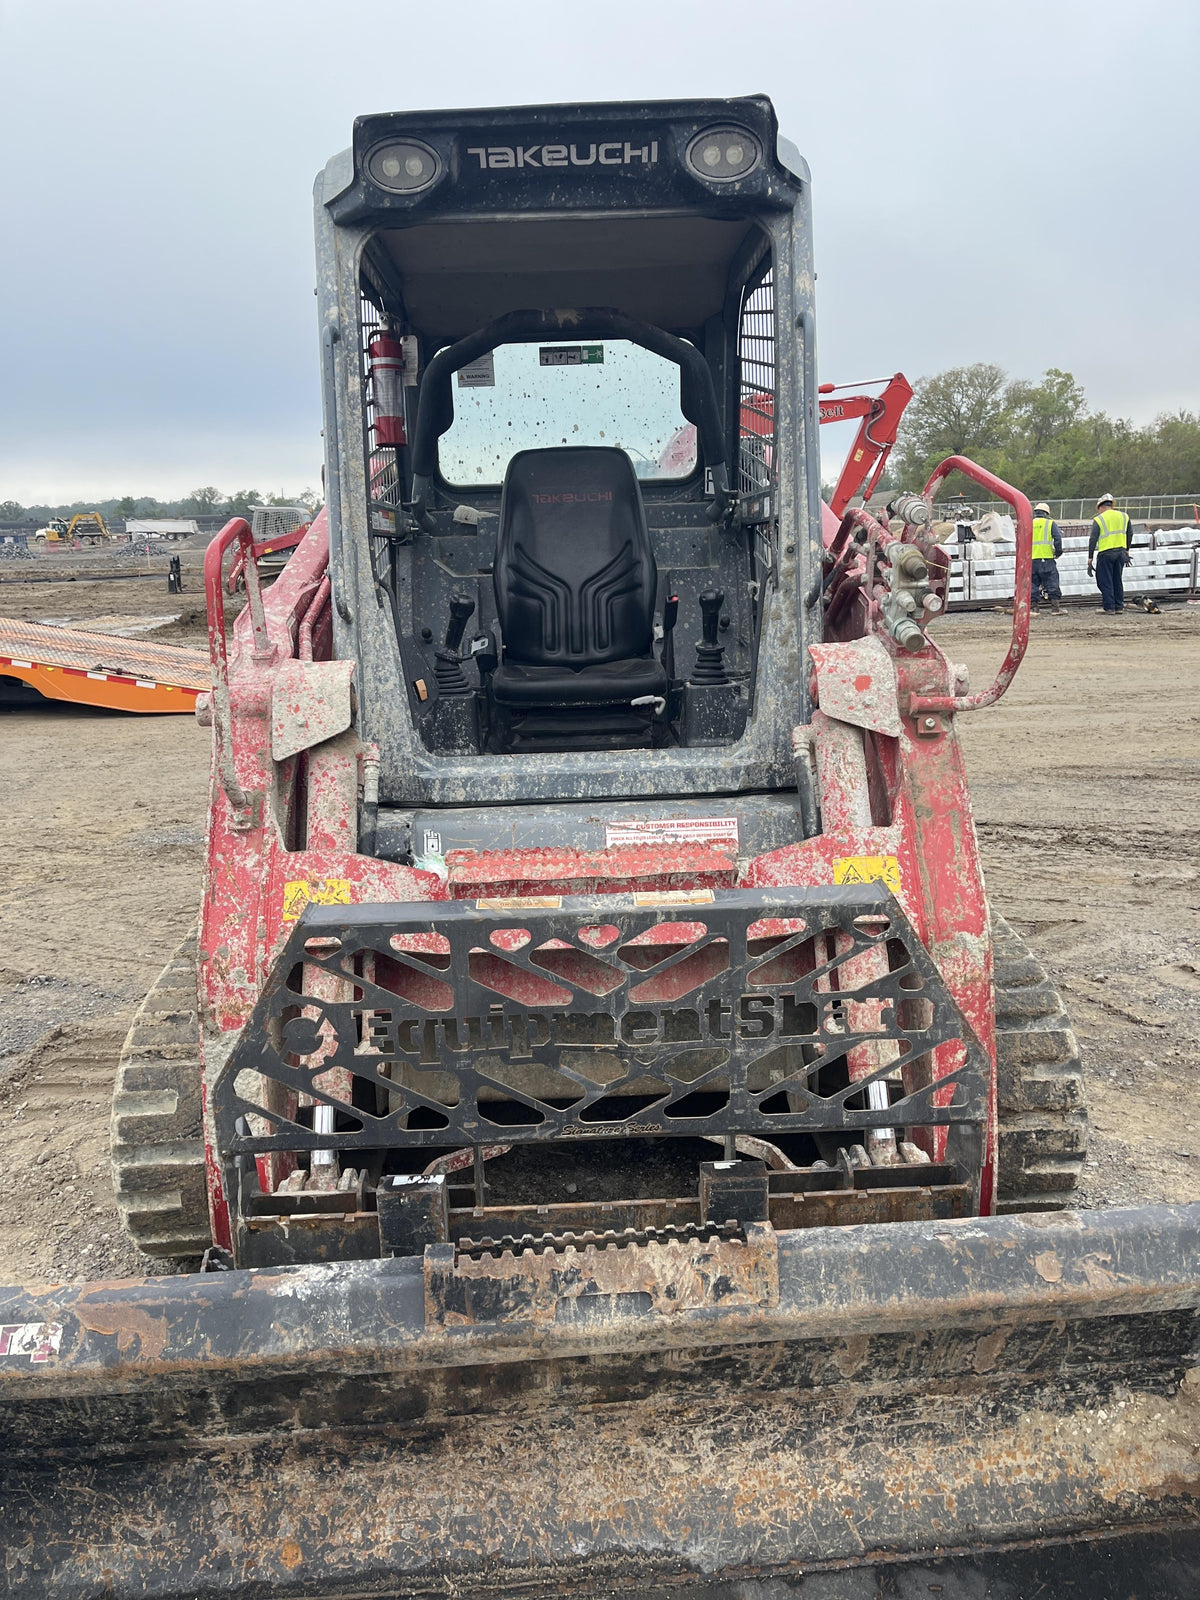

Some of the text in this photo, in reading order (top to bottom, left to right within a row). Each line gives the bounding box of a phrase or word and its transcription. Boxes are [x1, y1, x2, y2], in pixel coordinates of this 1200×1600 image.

[466, 140, 659, 169] TAKEUCHI
[531, 491, 614, 503] TAKEUCHI
[635, 822, 675, 831] CUSTOMER
[676, 820, 736, 828] RESPONSIBILITY
[624, 1121, 663, 1133] Series
